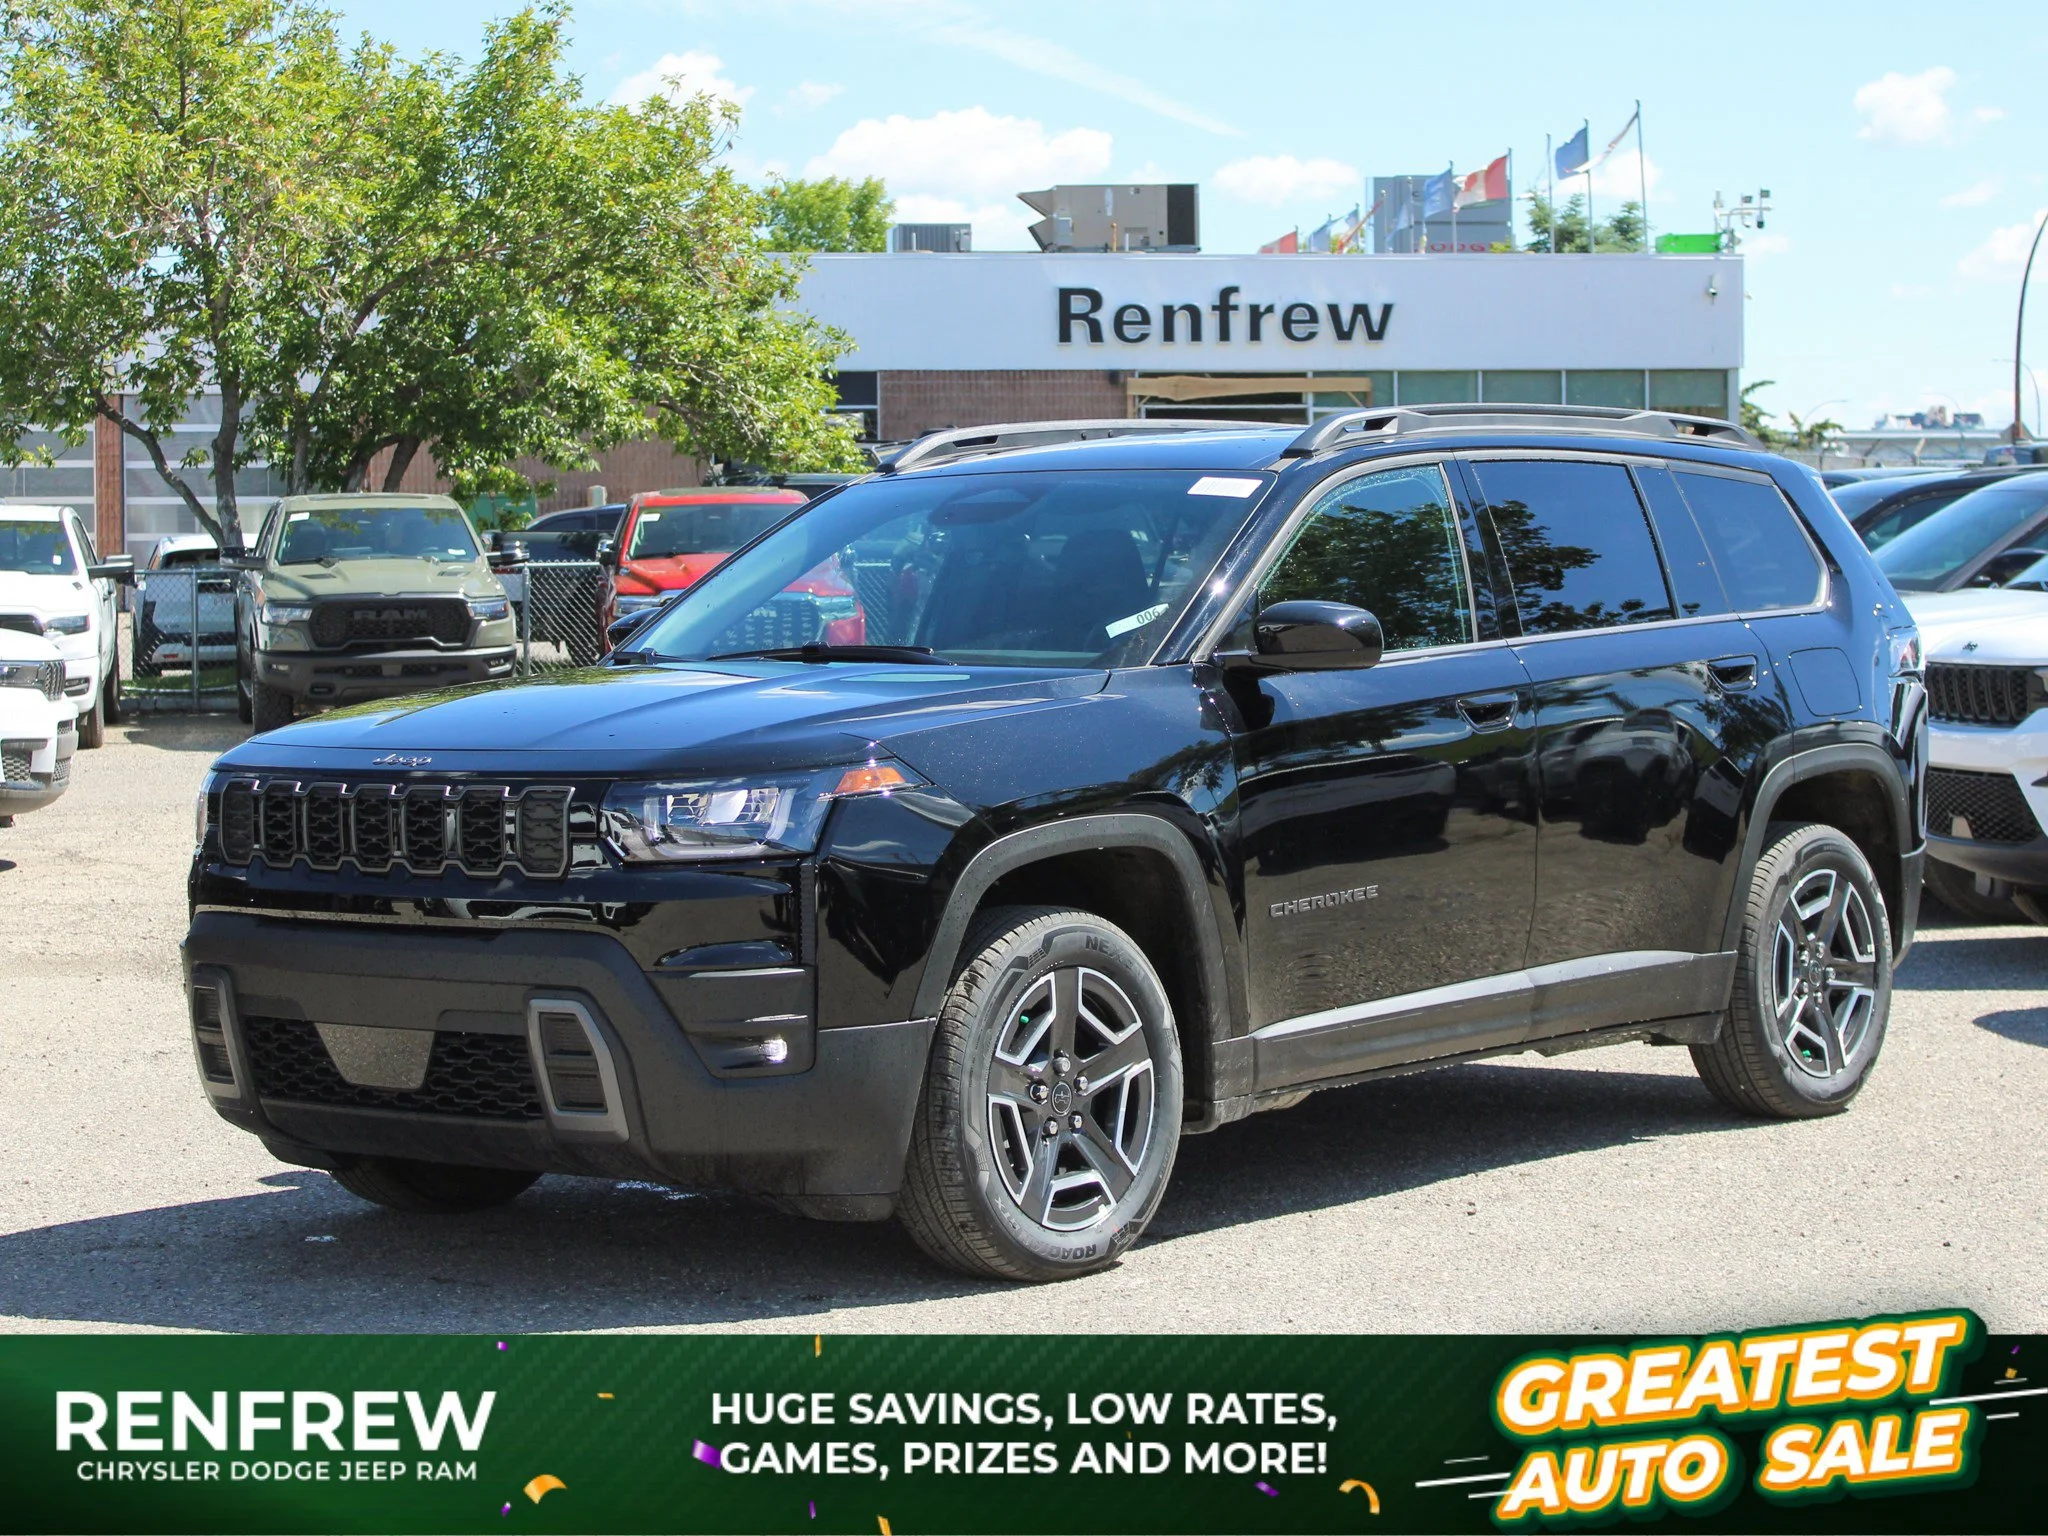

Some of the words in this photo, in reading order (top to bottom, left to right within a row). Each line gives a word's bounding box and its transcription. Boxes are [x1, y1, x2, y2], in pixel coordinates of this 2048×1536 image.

[1059, 286, 1393, 344] Renfrew
[353, 608, 428, 620] RAM
[1136, 607, 1161, 625] 006
[1269, 884, 1379, 918] CHEROKEE
